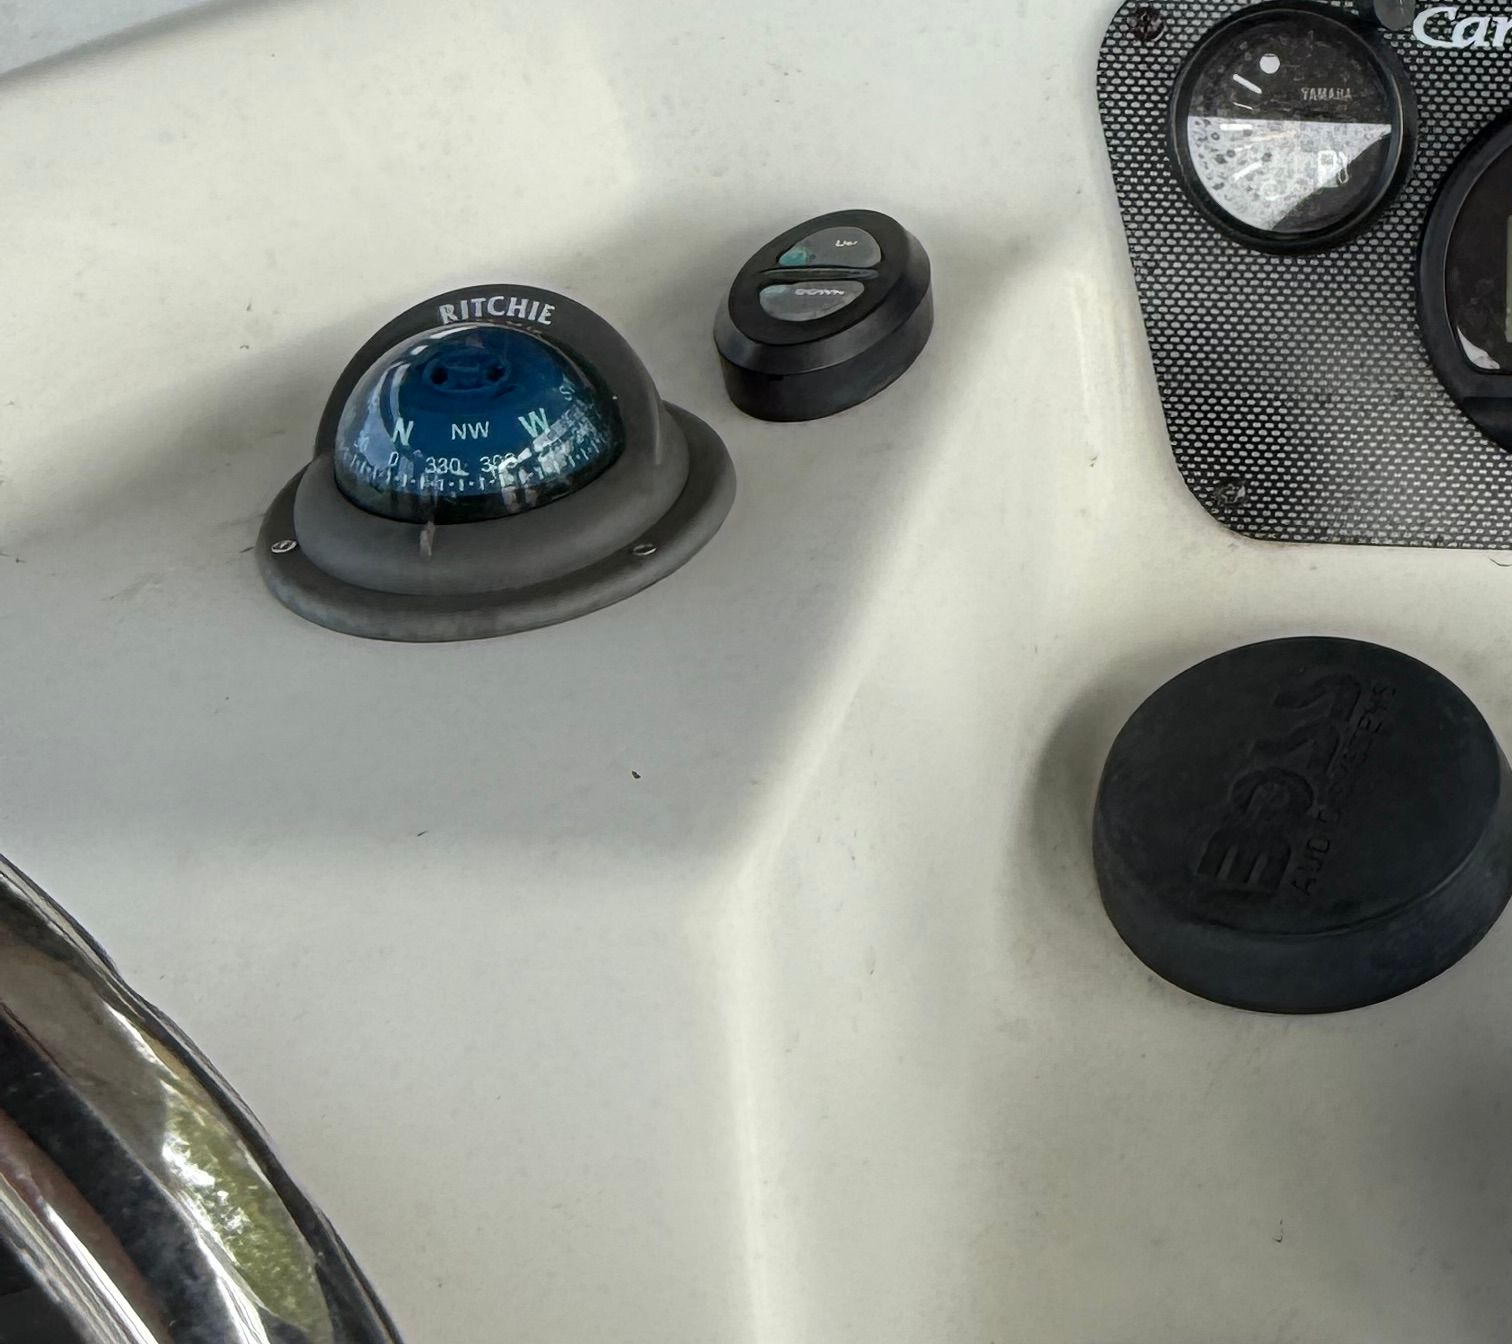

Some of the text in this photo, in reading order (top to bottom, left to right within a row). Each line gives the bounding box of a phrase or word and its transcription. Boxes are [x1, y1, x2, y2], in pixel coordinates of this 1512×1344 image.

[1300, 87, 1352, 102] YAMAHA
[438, 295, 556, 325] RITCHIE
[391, 408, 550, 447] N NW W
[425, 456, 462, 475] 330
